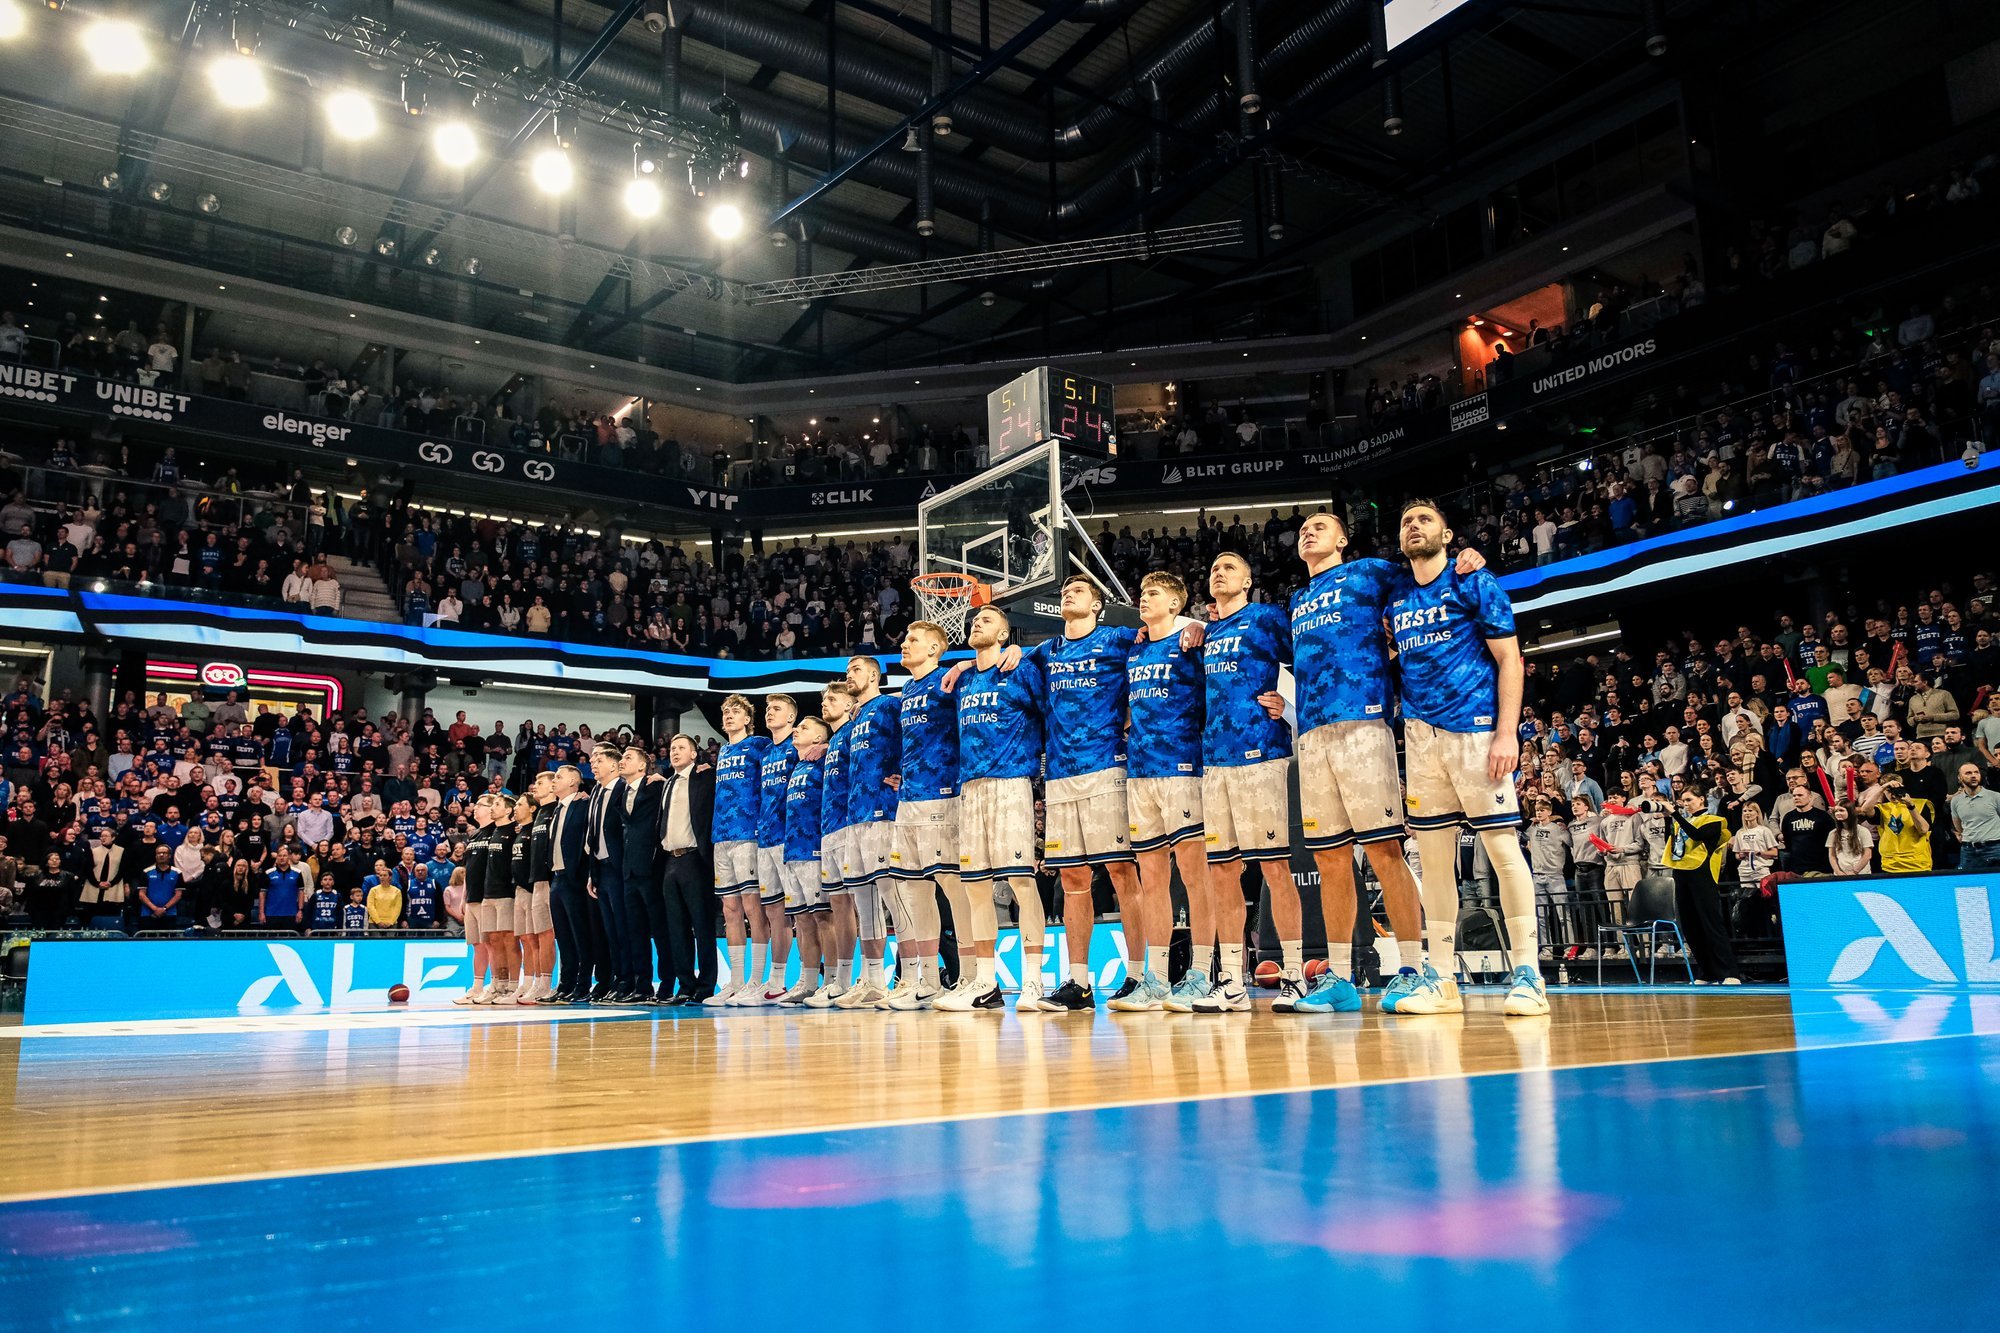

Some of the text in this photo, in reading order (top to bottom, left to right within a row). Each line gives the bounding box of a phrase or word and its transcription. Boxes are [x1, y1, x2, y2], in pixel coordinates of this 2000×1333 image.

[1588, 339, 1657, 375] MOTORS
[0, 364, 78, 393] NIBET
[96, 381, 191, 413] UNIBET
[1064, 378, 1096, 404] 5.1
[263, 412, 351, 447] elenger
[1061, 404, 1101, 442] 24
[1302, 427, 1405, 464] TALLINNA SADAM
[1186, 460, 1285, 478] BLRT GRUPP
[687, 488, 739, 511] YIT
[827, 488, 873, 504] CLIK
[1033, 601, 1062, 615] SPOR
[1394, 604, 1449, 634] EESTI
[1294, 611, 1342, 635] UTILITAS
[1402, 630, 1452, 651] UTILITAS
[1056, 677, 1097, 690] UTILITAS
[1128, 663, 1172, 684] EESTI
[1134, 687, 1169, 700] UTILITAS
[962, 712, 998, 726] UTILITAS
[1461, 835, 1475, 843] EST
[1535, 830, 1551, 839] EST
[1290, 871, 1321, 886] TILIT
[1827, 886, 2000, 983] AL
